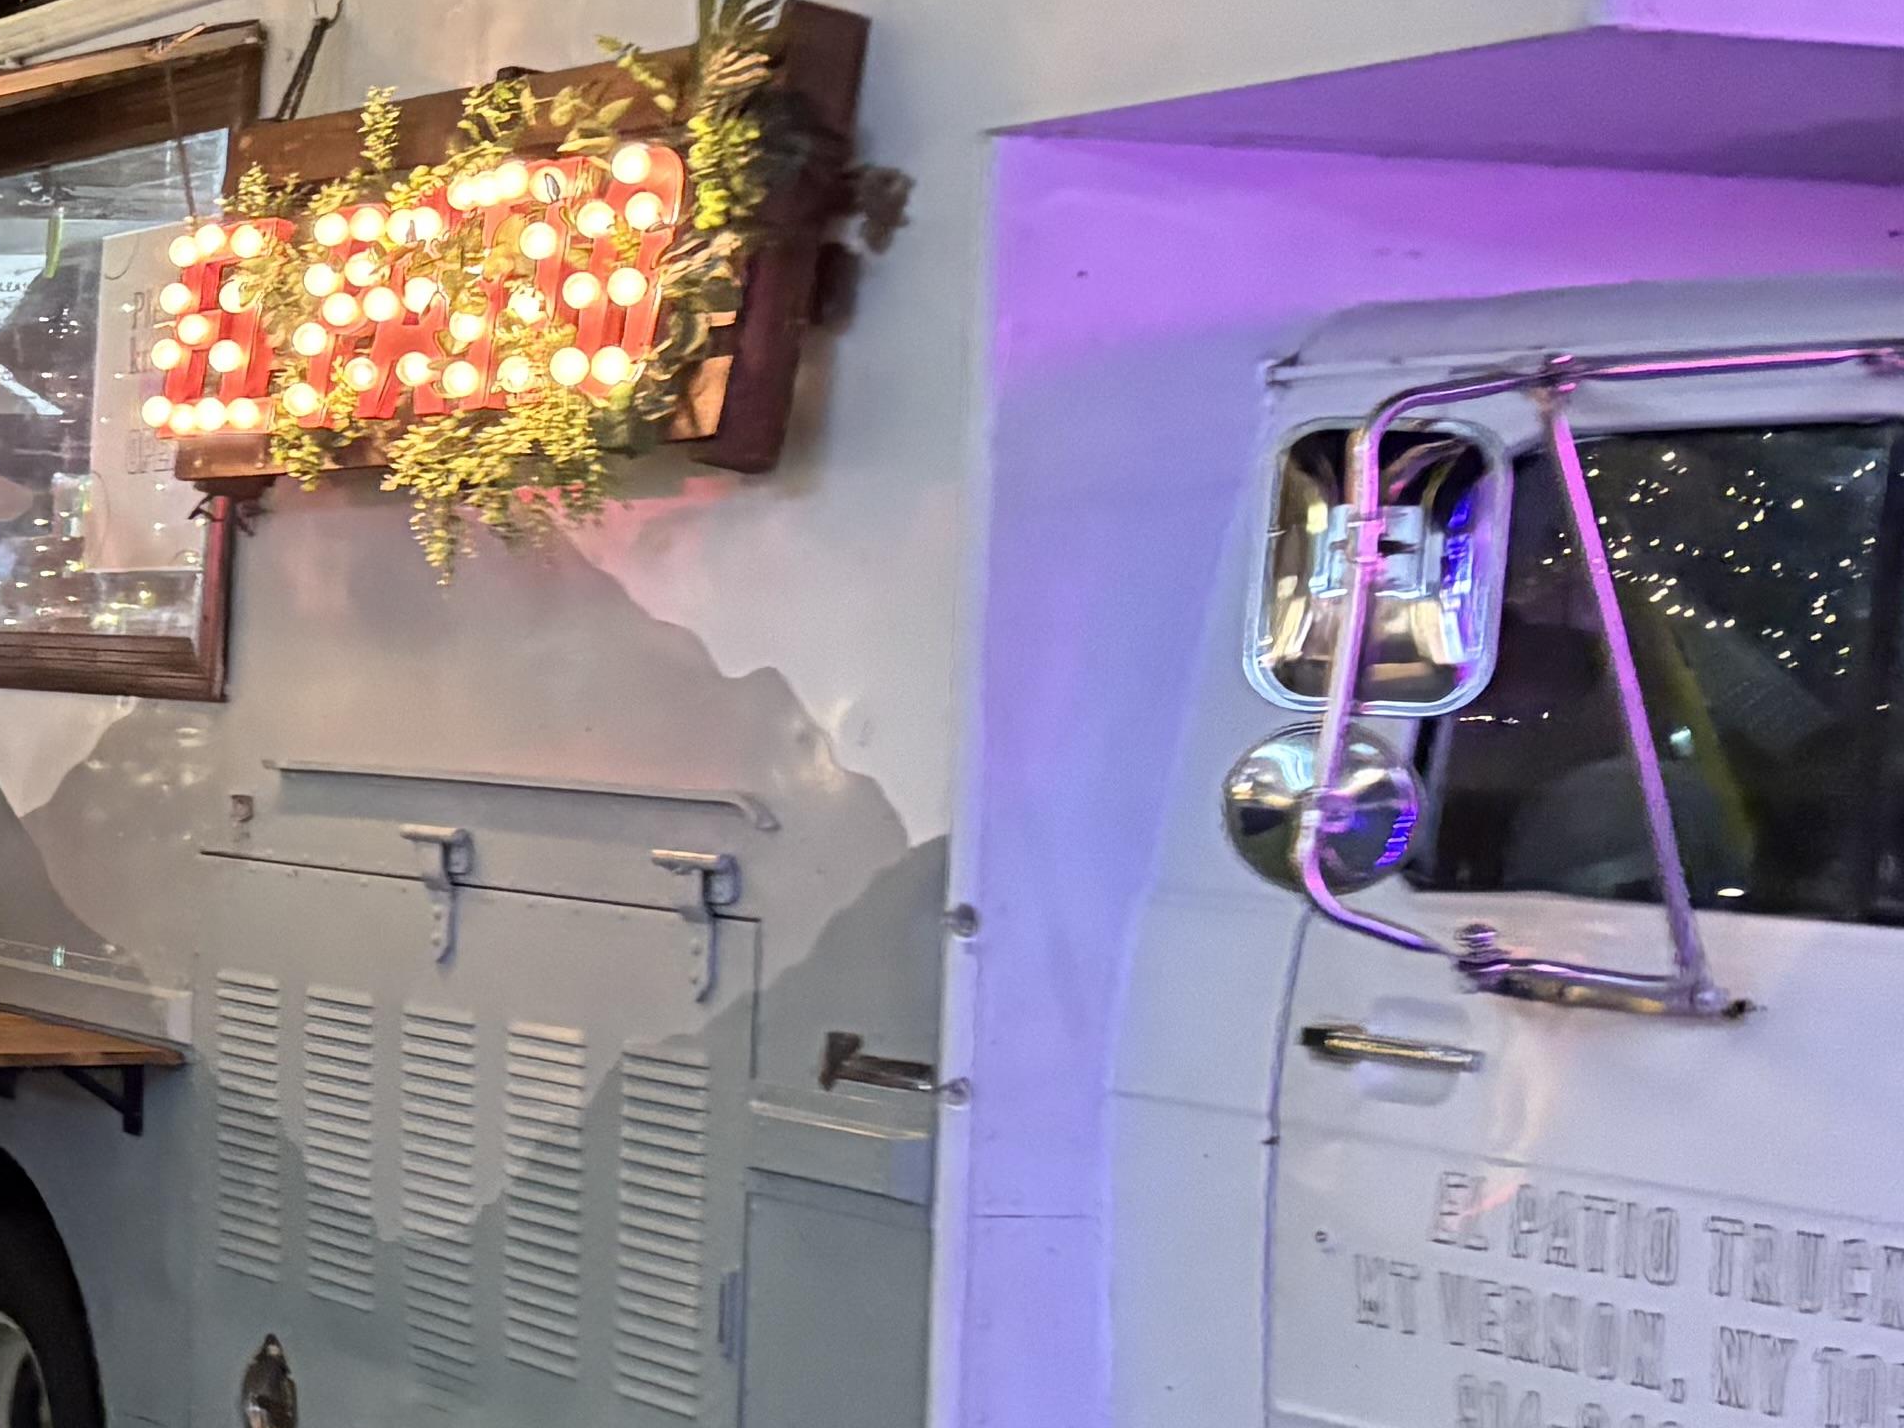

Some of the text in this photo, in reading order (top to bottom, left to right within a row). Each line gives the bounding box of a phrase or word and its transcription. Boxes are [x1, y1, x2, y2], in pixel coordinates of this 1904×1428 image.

[290, 142, 685, 430] PATIO
[1428, 1172, 1488, 1251] EL
[1508, 1183, 1680, 1286] PATIO
[1352, 1254, 1420, 1334] MT
[1713, 1325, 1799, 1416] NY
